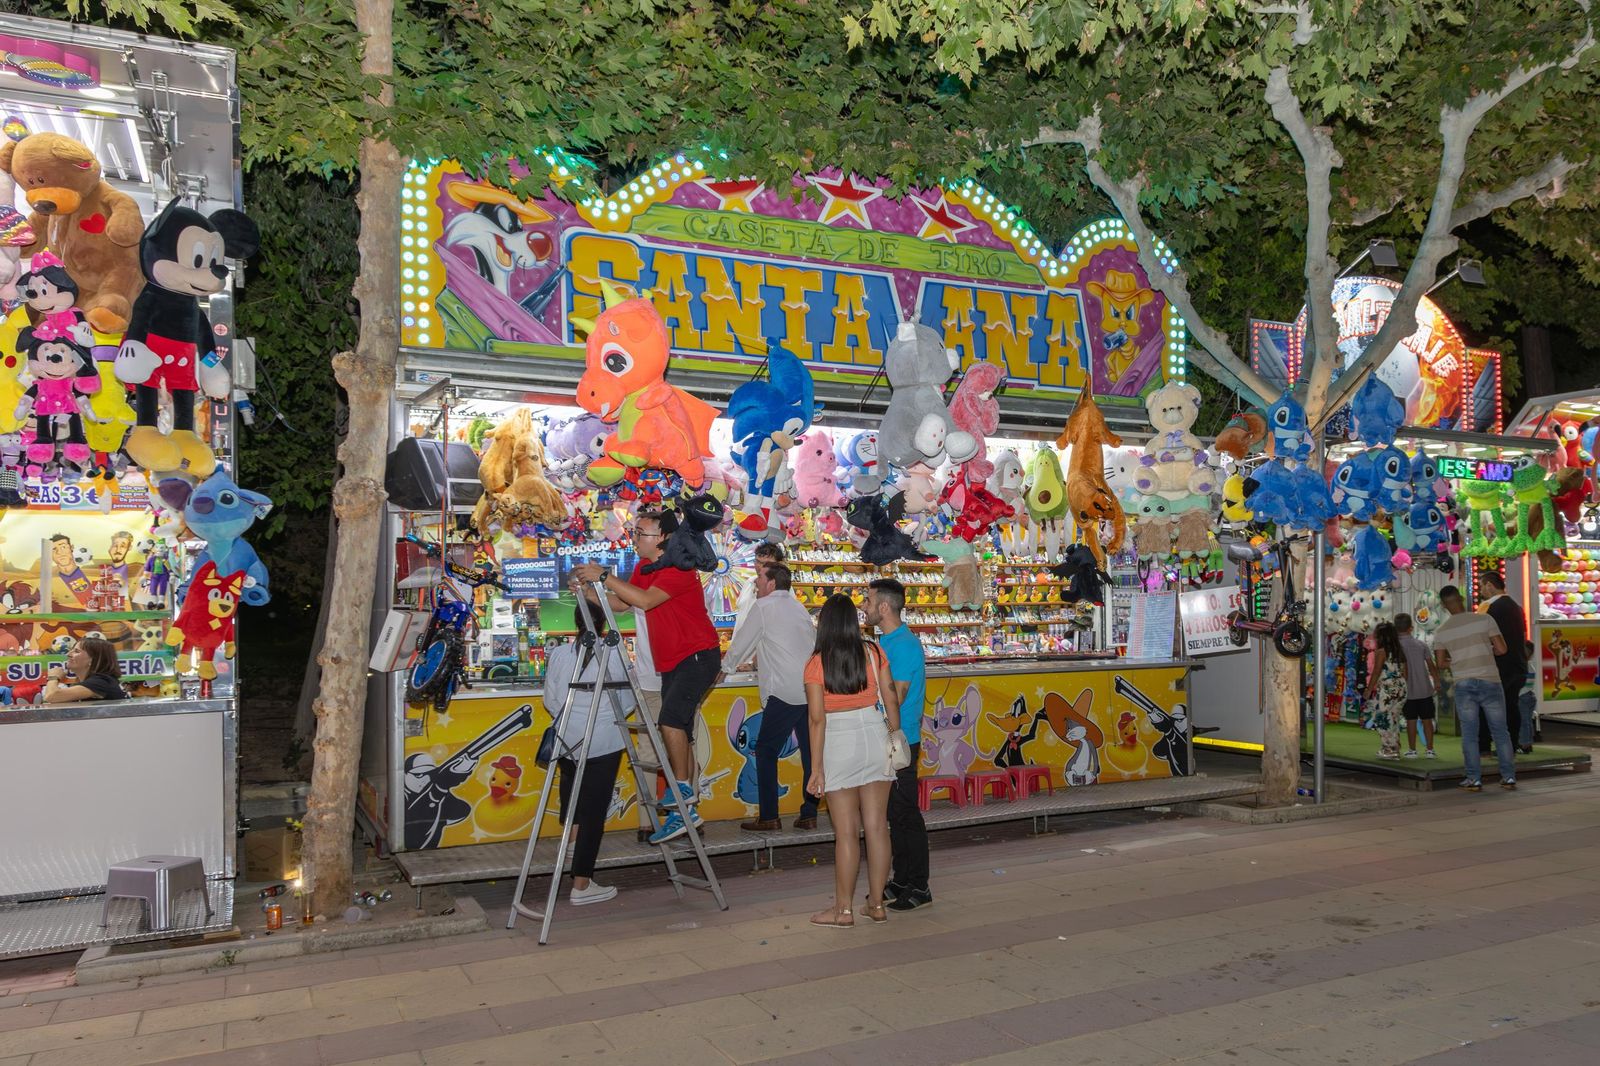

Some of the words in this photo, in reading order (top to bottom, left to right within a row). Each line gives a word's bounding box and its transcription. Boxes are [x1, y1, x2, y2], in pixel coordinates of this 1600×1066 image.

[683, 213, 835, 256] CASETA
[858, 233, 900, 263] DE
[928, 244, 1007, 279] TIRO
[567, 235, 884, 366] SANTA
[942, 285, 1087, 388] ANA
[1195, 615, 1227, 634] TIROS
[1188, 637, 1223, 649] SIEMPRE
[8, 663, 41, 681] SU
